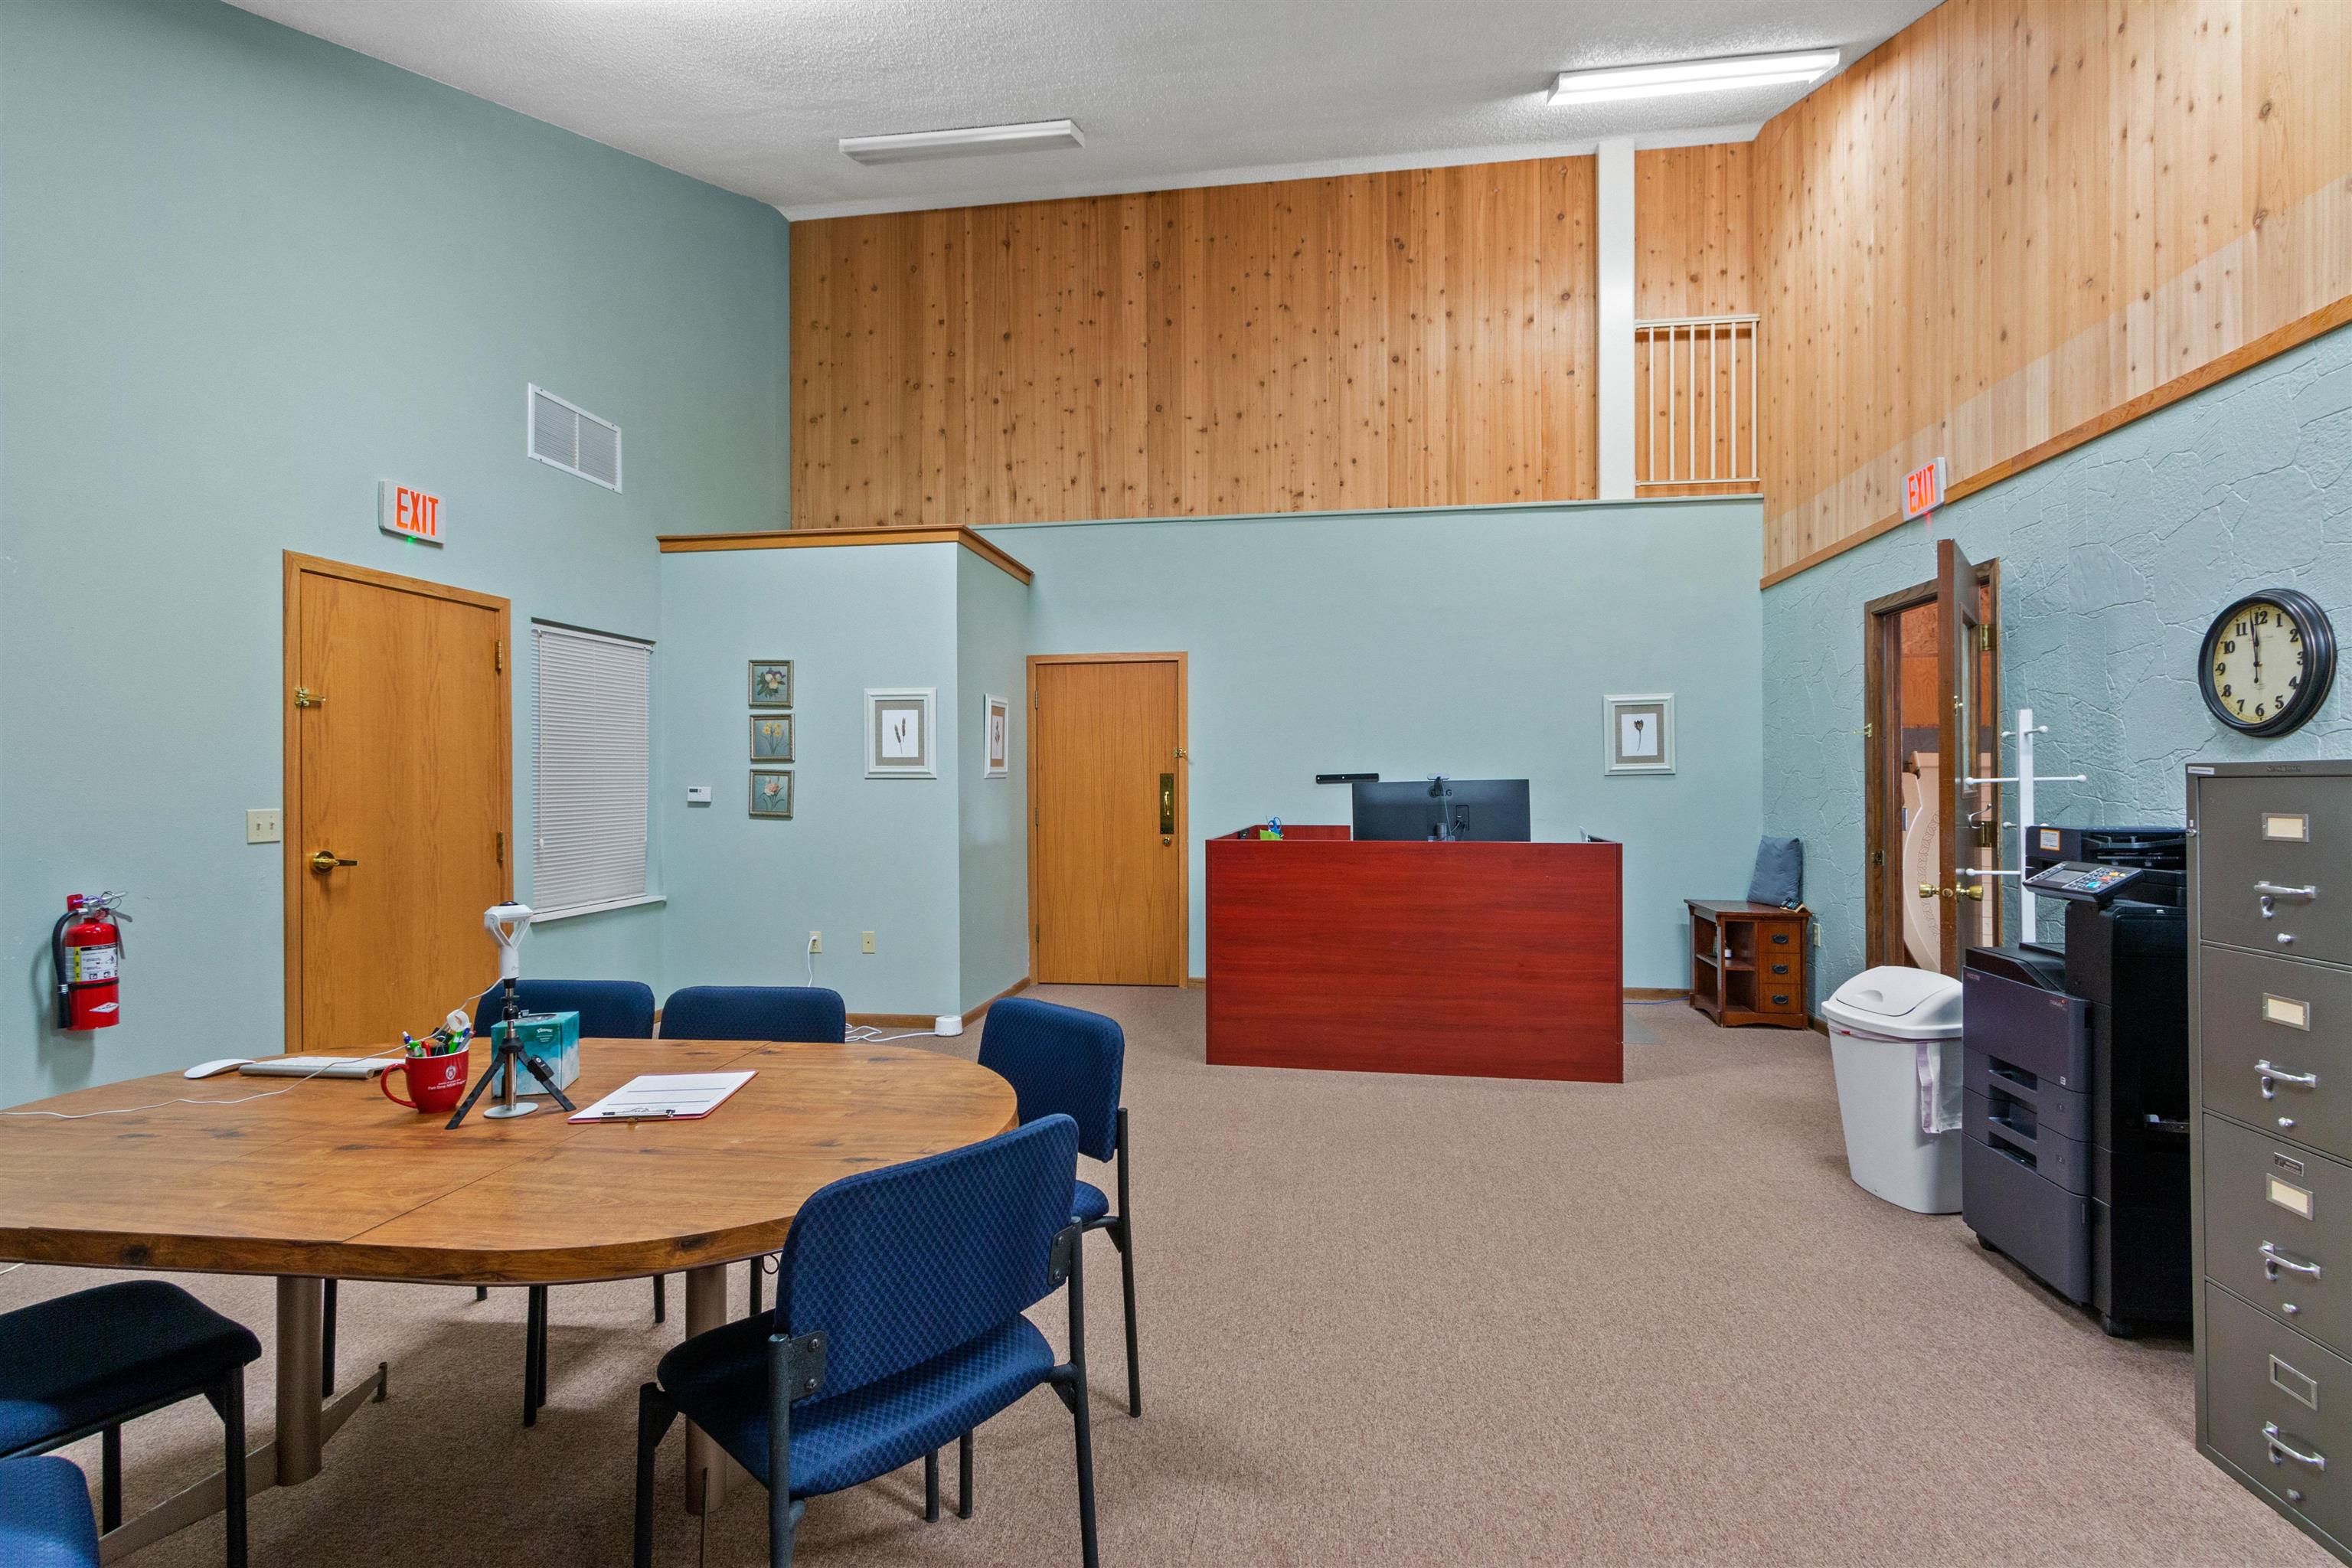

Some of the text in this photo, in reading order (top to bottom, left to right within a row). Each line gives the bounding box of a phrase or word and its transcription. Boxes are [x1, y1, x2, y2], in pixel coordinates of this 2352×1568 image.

[1908, 463, 1934, 514] EXIT
[396, 485, 439, 537] EXIT
[2254, 611, 2268, 626] 12
[2276, 613, 2282, 627] 1
[2236, 622, 2248, 636] 11
[2290, 629, 2298, 642] 2
[2223, 640, 2236, 654] 10
[2297, 651, 2304, 665] 3
[2217, 662, 2226, 675] 9
[2288, 676, 2299, 690] 4
[2223, 684, 2231, 697] 8
[2236, 699, 2245, 712] 7
[2275, 694, 2284, 710] 5
[2255, 703, 2265, 717] 6
